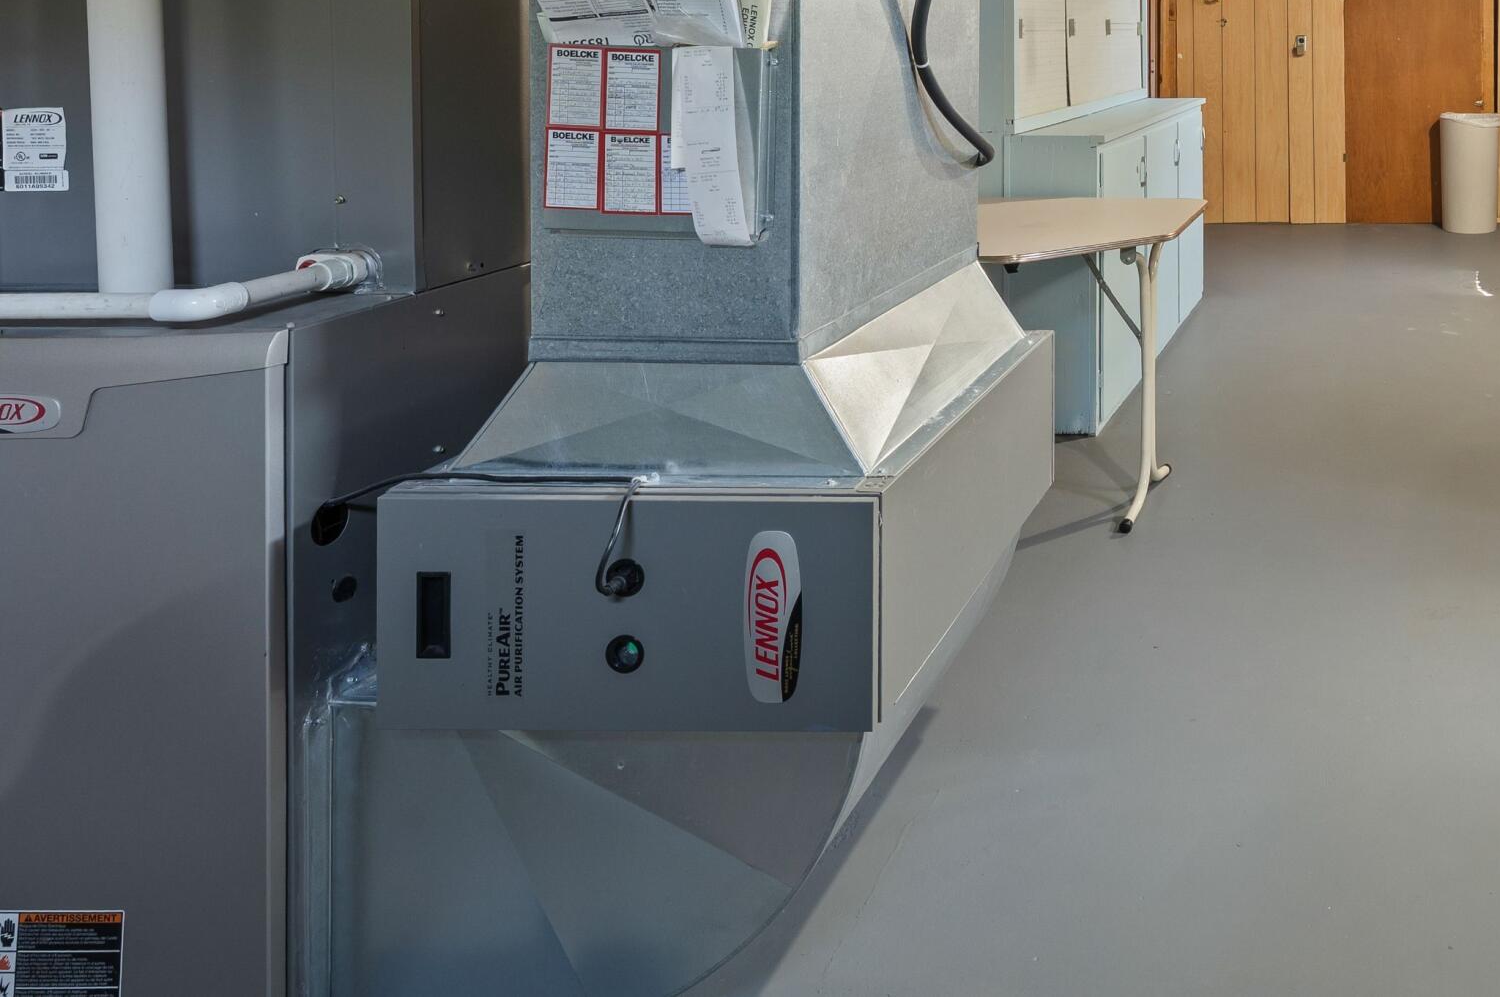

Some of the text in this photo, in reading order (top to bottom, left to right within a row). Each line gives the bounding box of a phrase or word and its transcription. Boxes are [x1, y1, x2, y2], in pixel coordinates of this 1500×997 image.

[747, 4, 758, 41] LENNOX
[557, 50, 599, 59] BOELCKE
[612, 53, 654, 62] BOELCKE
[14, 114, 53, 123] LENNOX
[552, 132, 594, 141] BOELCKE
[515, 535, 524, 697] AIR PURIFICATION SYSTEM
[755, 575, 780, 682] LENNOX
[34, 913, 117, 923] AVERTISSEMENT
